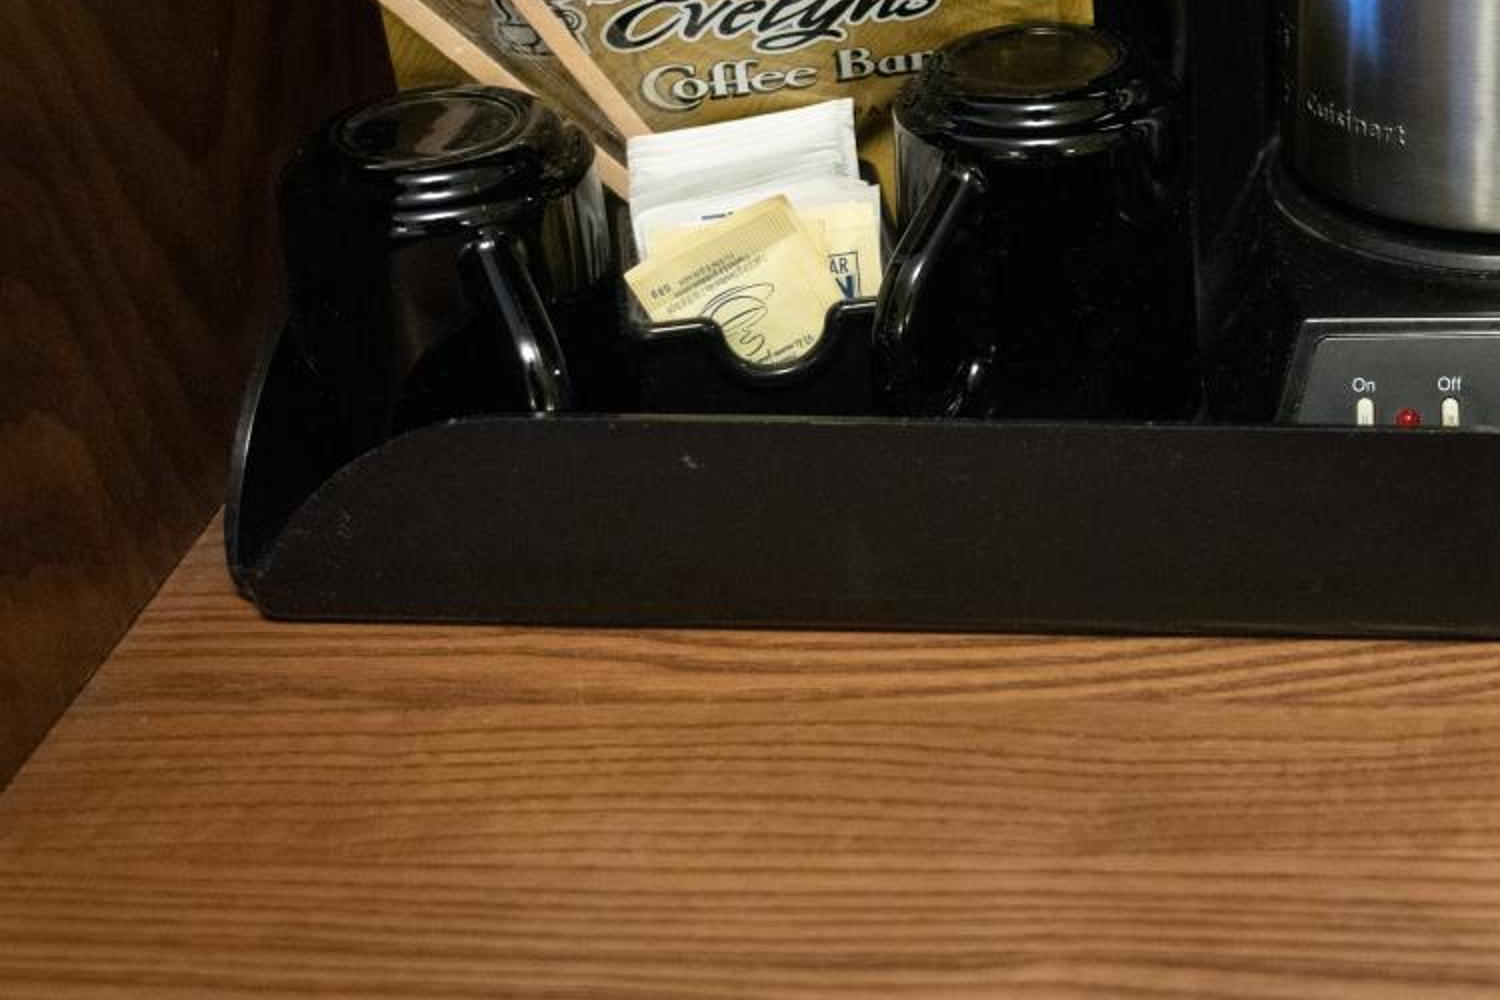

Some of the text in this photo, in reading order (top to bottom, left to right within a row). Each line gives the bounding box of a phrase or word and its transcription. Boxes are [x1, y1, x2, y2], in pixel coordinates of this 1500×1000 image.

[641, 48, 934, 111] Coffee Bar
[1352, 377, 1376, 393] On
[1437, 376, 1462, 392] Off
